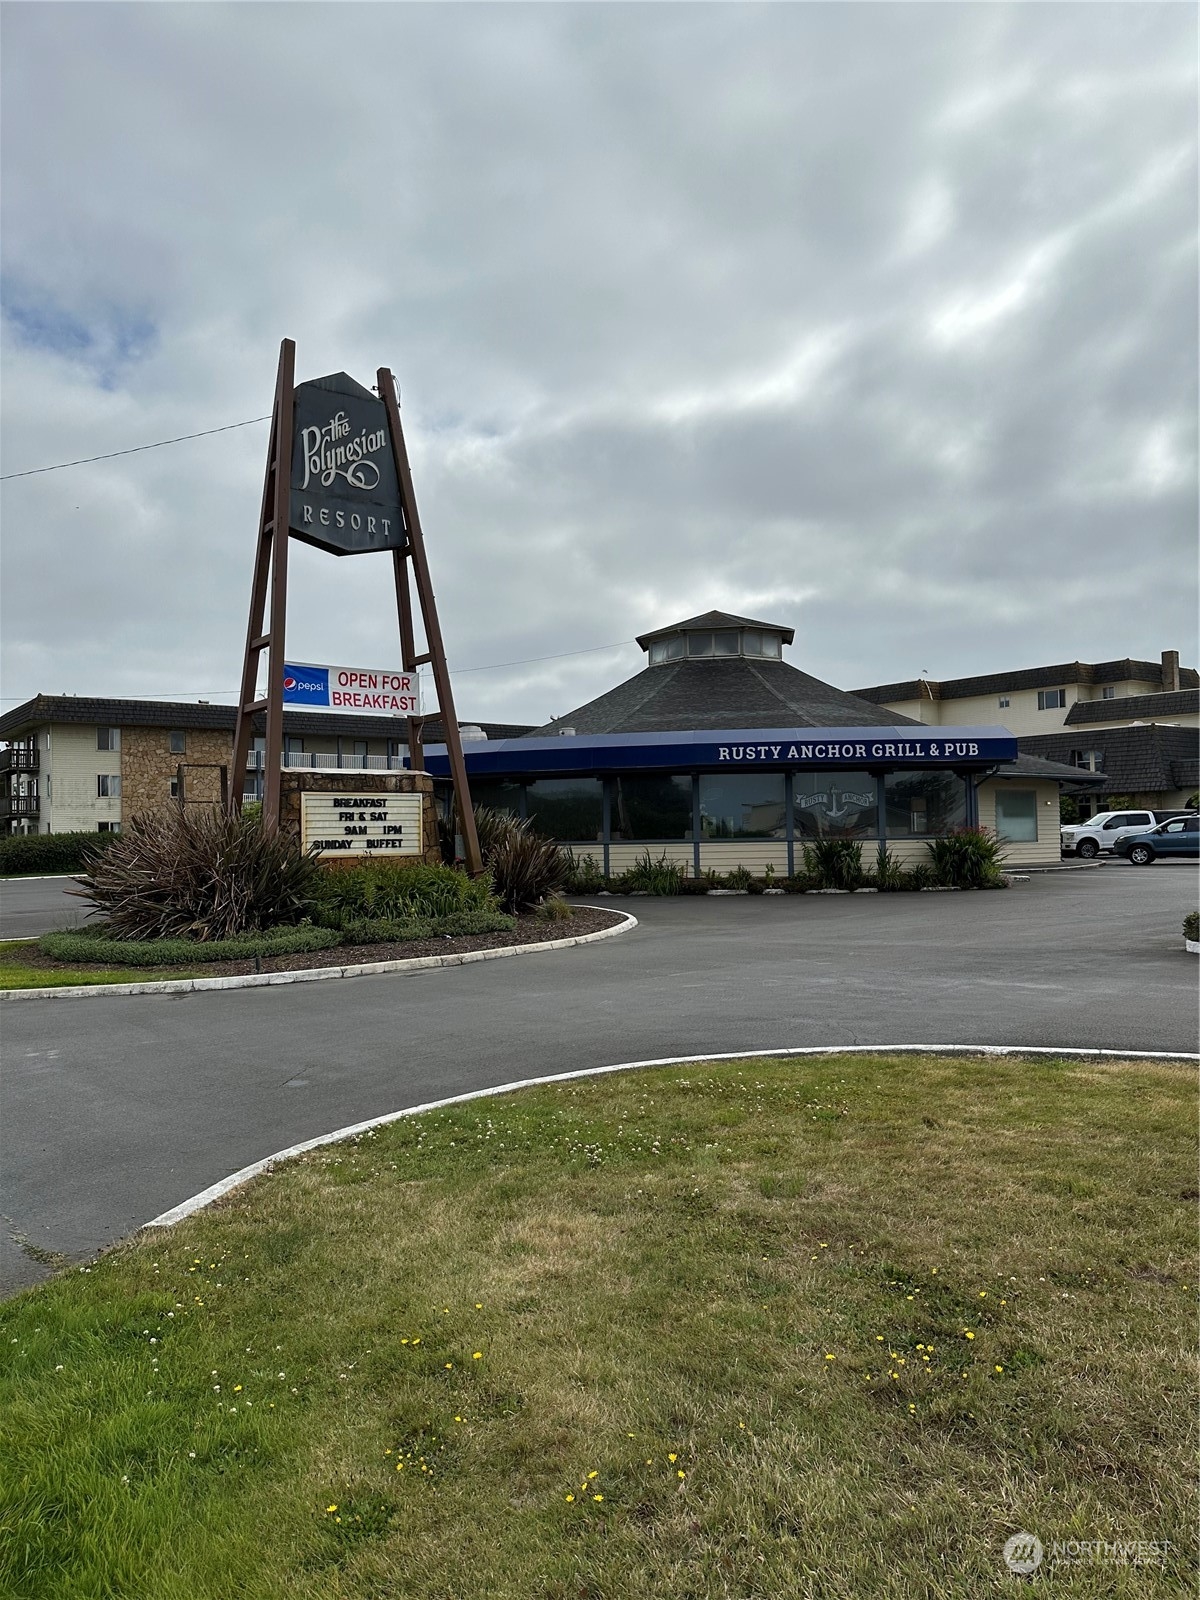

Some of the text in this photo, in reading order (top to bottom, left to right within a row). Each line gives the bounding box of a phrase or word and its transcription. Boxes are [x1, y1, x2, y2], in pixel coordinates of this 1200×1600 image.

[321, 411, 351, 442] the
[301, 425, 386, 490] Polynesian
[303, 505, 391, 536] RESORT
[298, 682, 324, 692] pepsi
[338, 671, 411, 691] OPEN FOR
[332, 691, 417, 711] BREAKFAST
[718, 743, 979, 760] RUSTY ANCHOR GRILL & PUB
[333, 798, 388, 808] BREAKFAST
[804, 793, 868, 807] RUSTY ANCHOR
[339, 811, 388, 822] FRI & SAT
[344, 825, 402, 835] 9AM 1PM
[313, 839, 403, 849] SUNDAY BUFFET
